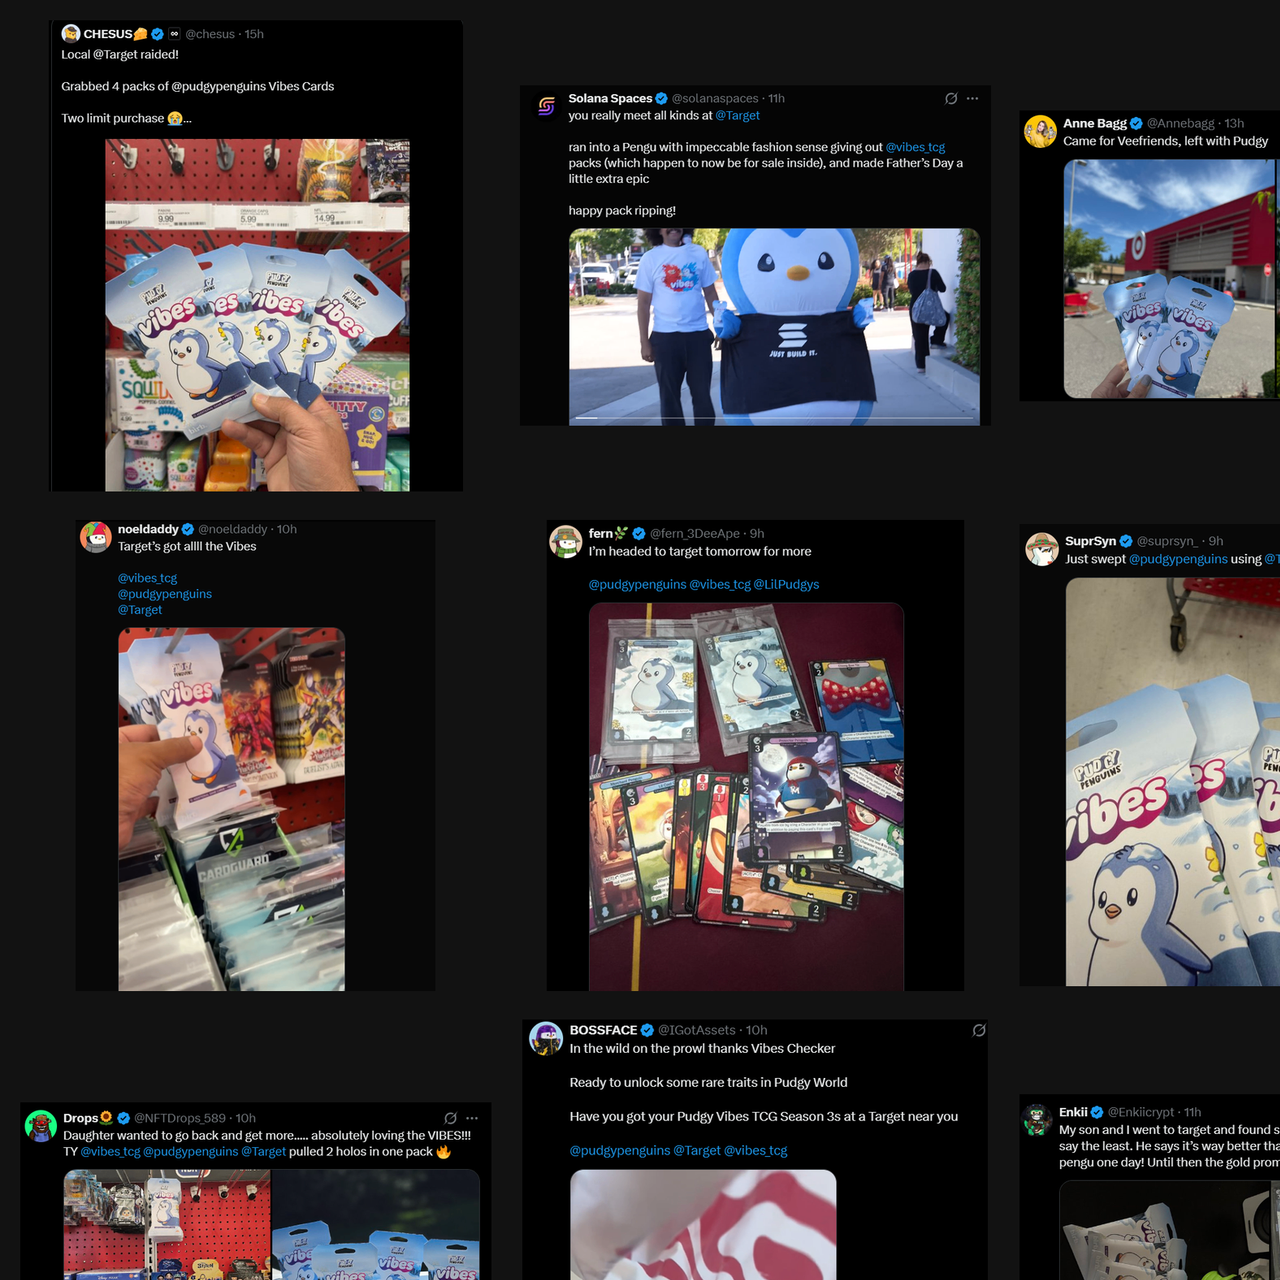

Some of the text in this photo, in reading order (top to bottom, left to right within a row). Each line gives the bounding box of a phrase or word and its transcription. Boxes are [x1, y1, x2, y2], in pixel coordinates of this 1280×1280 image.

[61, 80, 335, 94] Grabbed 4 packs of @pudgypenguins Vibes Cards
[315, 214, 335, 222] 14.99
[568, 204, 676, 218] happy pack ripping!
[138, 297, 196, 338] vibes
[162, 541, 182, 554] got
[204, 540, 224, 552] the
[225, 540, 257, 552] Vibes
[161, 681, 213, 709] vibes
